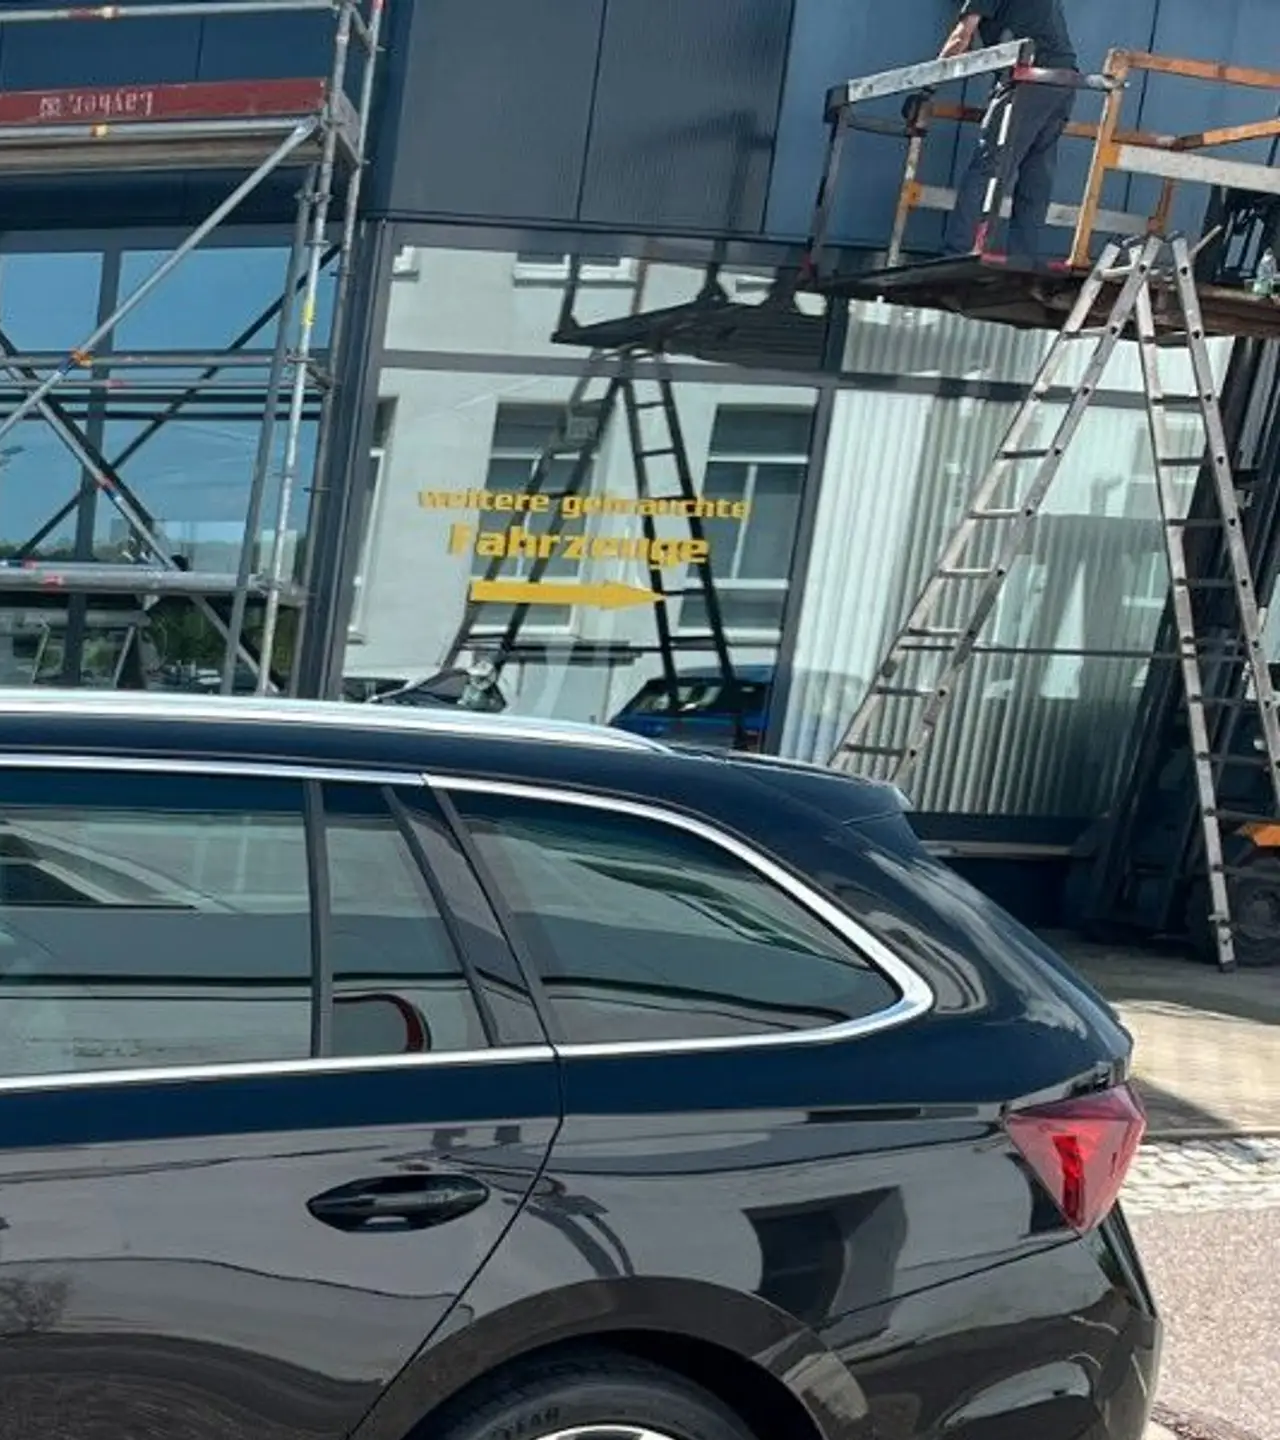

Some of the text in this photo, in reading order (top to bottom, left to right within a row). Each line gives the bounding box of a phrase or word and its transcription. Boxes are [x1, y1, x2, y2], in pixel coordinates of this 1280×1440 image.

[419, 489, 750, 519] weitere gebrauchte
[448, 524, 710, 569] Fahrzeuge
